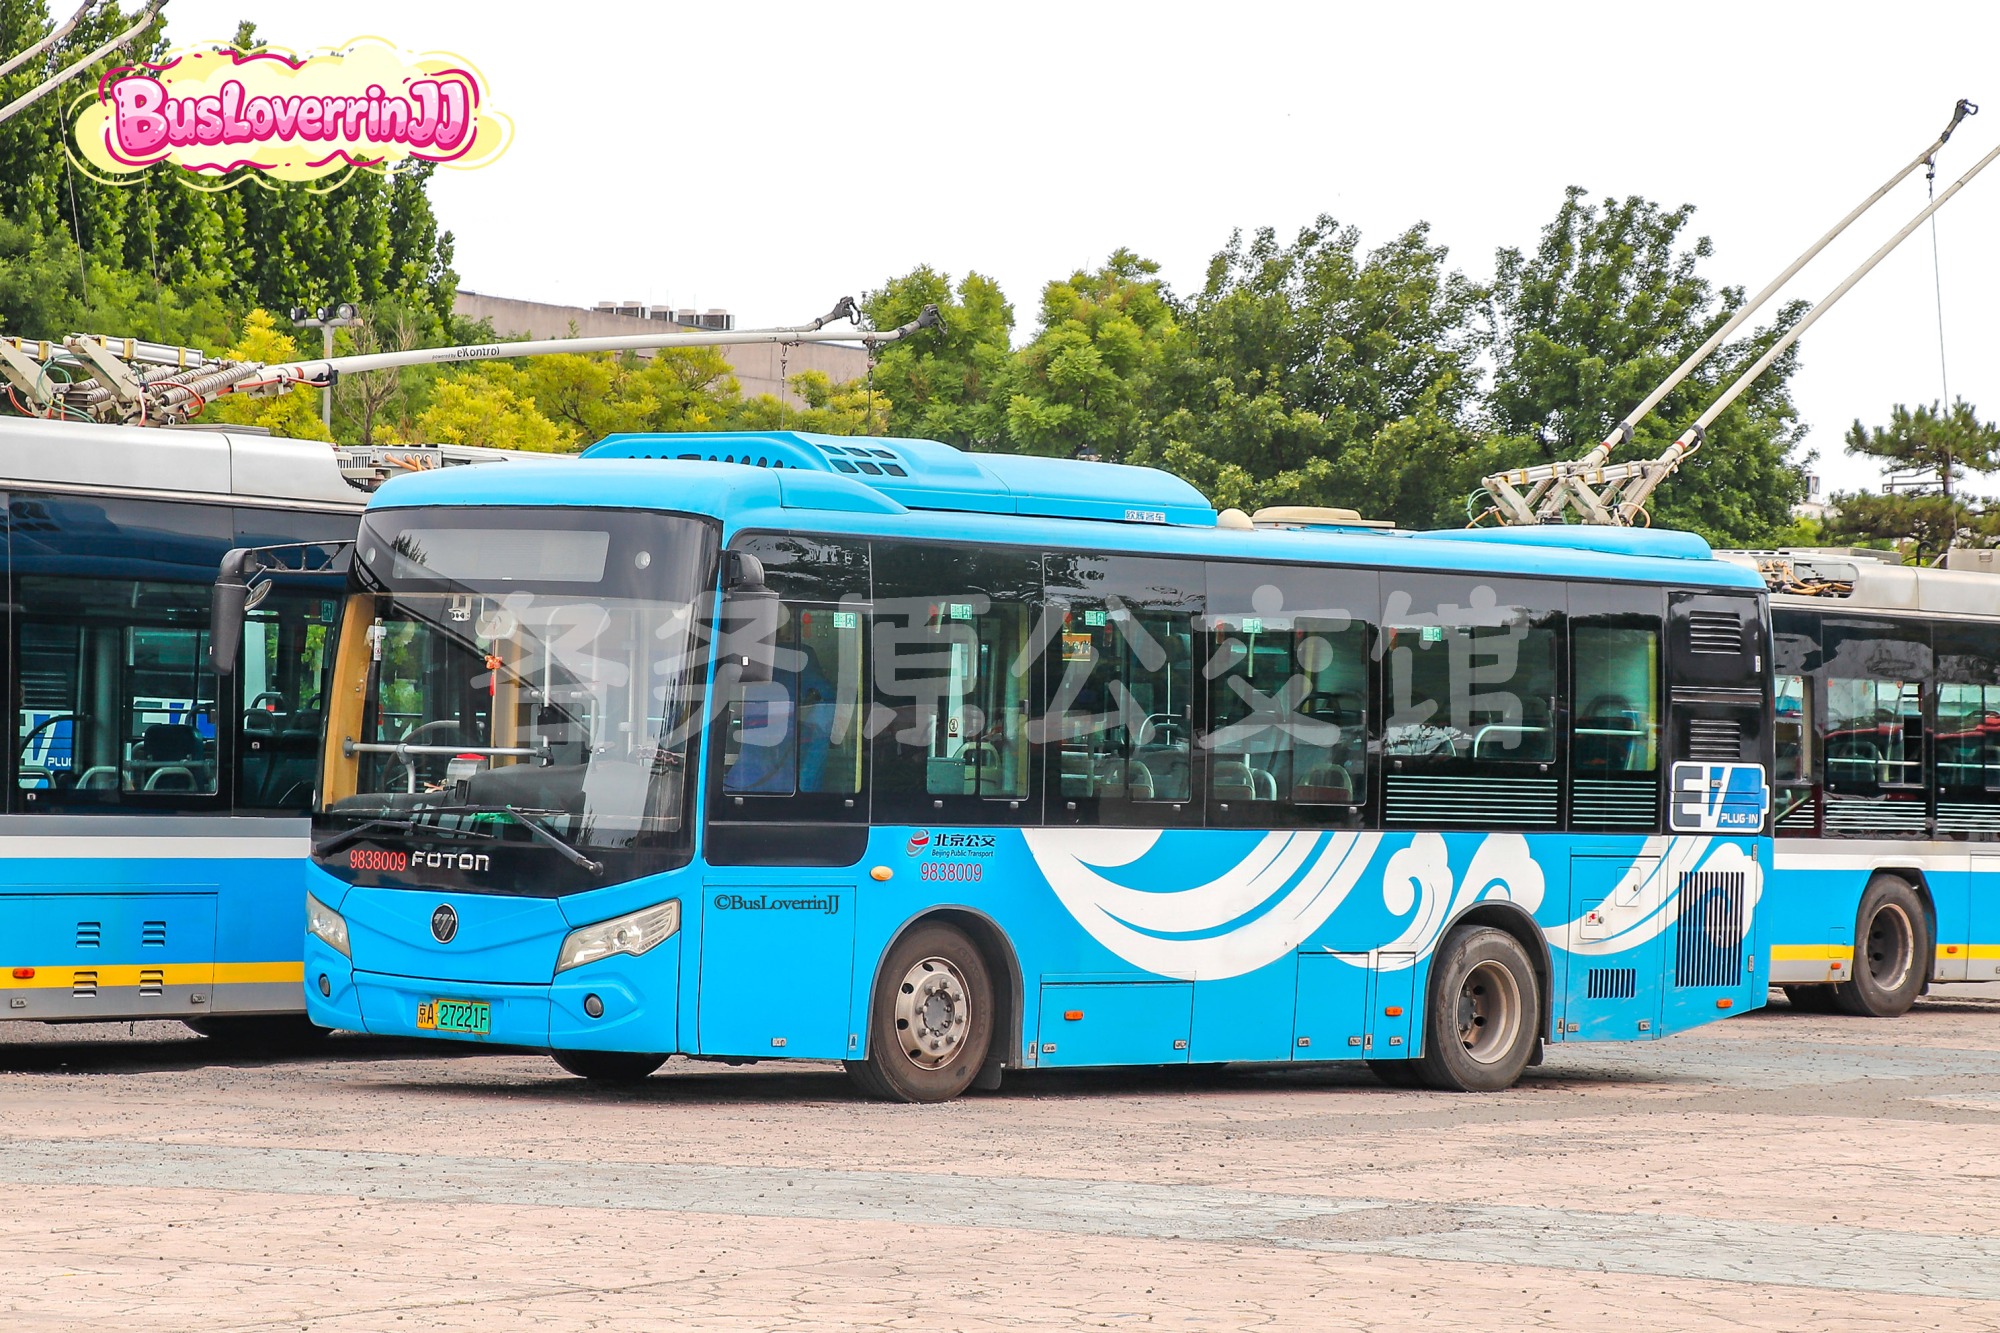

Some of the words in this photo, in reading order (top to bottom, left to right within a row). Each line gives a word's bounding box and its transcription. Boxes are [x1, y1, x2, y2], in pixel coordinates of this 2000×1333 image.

[457, 346, 500, 358] eKontrol
[1720, 812, 1758, 824] PLUG-IN
[933, 833, 997, 847] 北京公交
[349, 849, 406, 872] 9838009
[411, 850, 490, 871] FOTON
[931, 849, 950, 858] Beijing
[950, 849, 967, 857] Public
[967, 849, 994, 858] Transport
[920, 862, 982, 882] 9838009
[440, 1004, 488, 1029] 27221F
